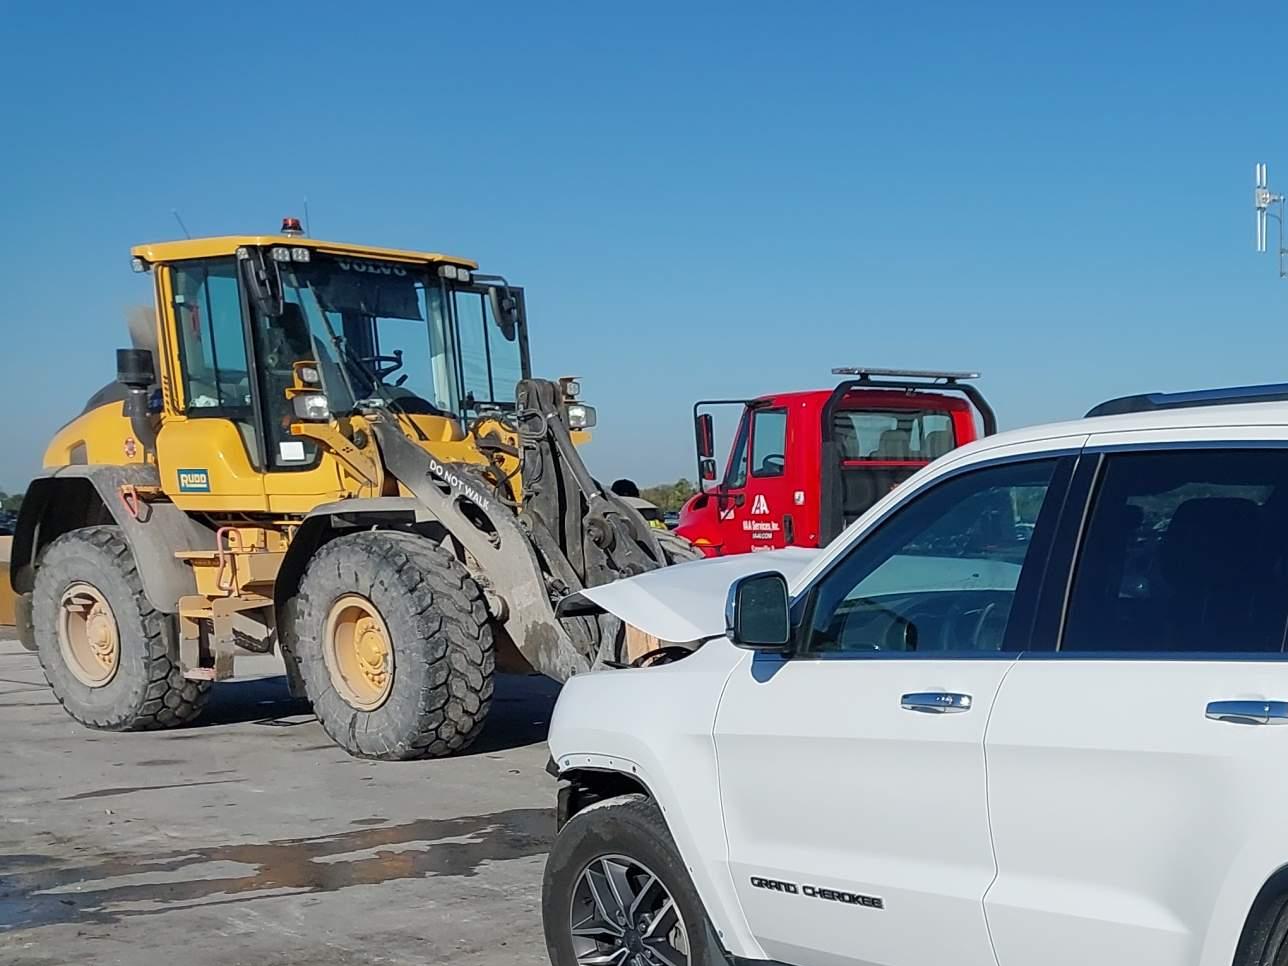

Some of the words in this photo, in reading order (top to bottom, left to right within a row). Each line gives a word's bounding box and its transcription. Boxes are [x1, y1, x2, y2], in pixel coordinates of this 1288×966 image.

[339, 261, 407, 276] VOLVO
[180, 473, 208, 488] RUDD
[429, 459, 444, 476] DO
[443, 470, 465, 490] NOT
[464, 484, 490, 511] WALK
[750, 876, 799, 894] GRAND
[802, 885, 884, 909] CHEROKEE
